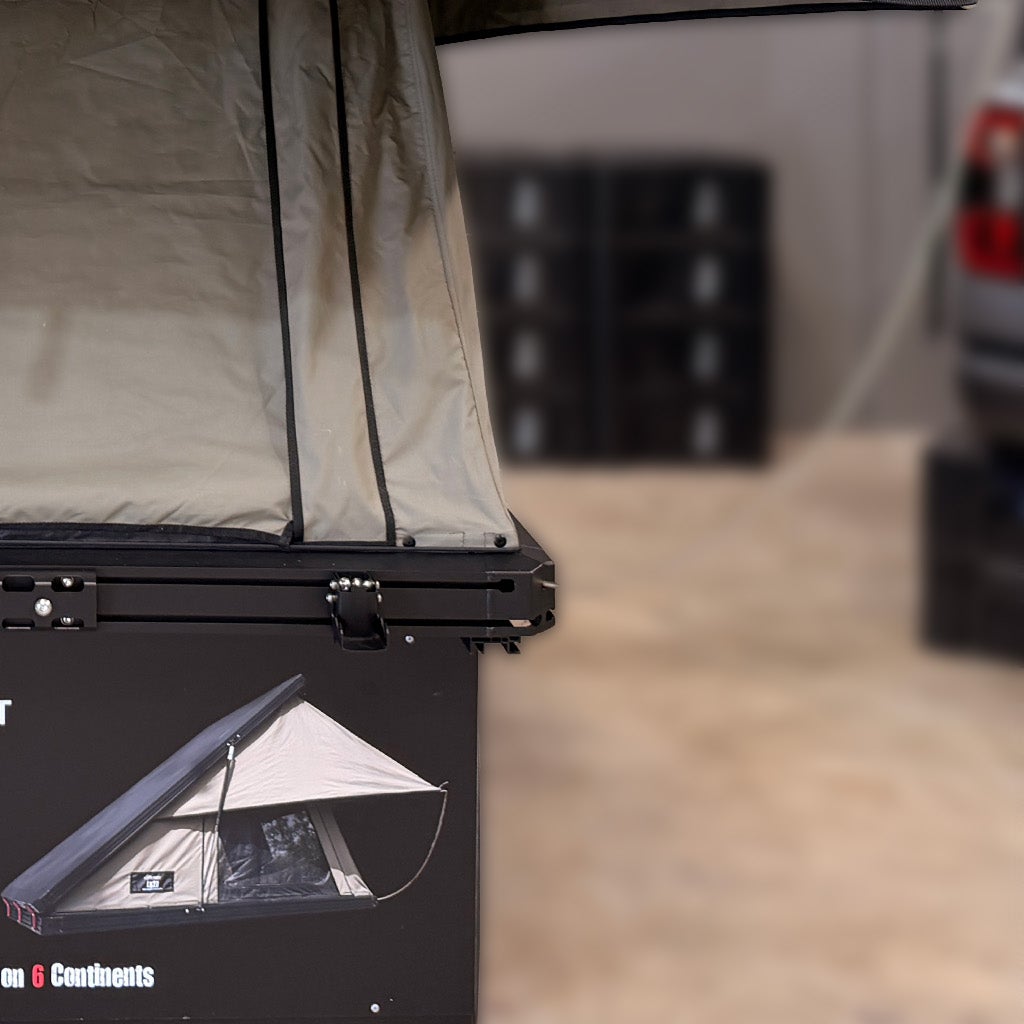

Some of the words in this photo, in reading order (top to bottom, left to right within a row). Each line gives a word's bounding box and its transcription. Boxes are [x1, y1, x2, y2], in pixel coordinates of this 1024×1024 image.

[0, 967, 25, 989] on
[31, 964, 45, 989] 6
[50, 962, 155, 988] Continents
